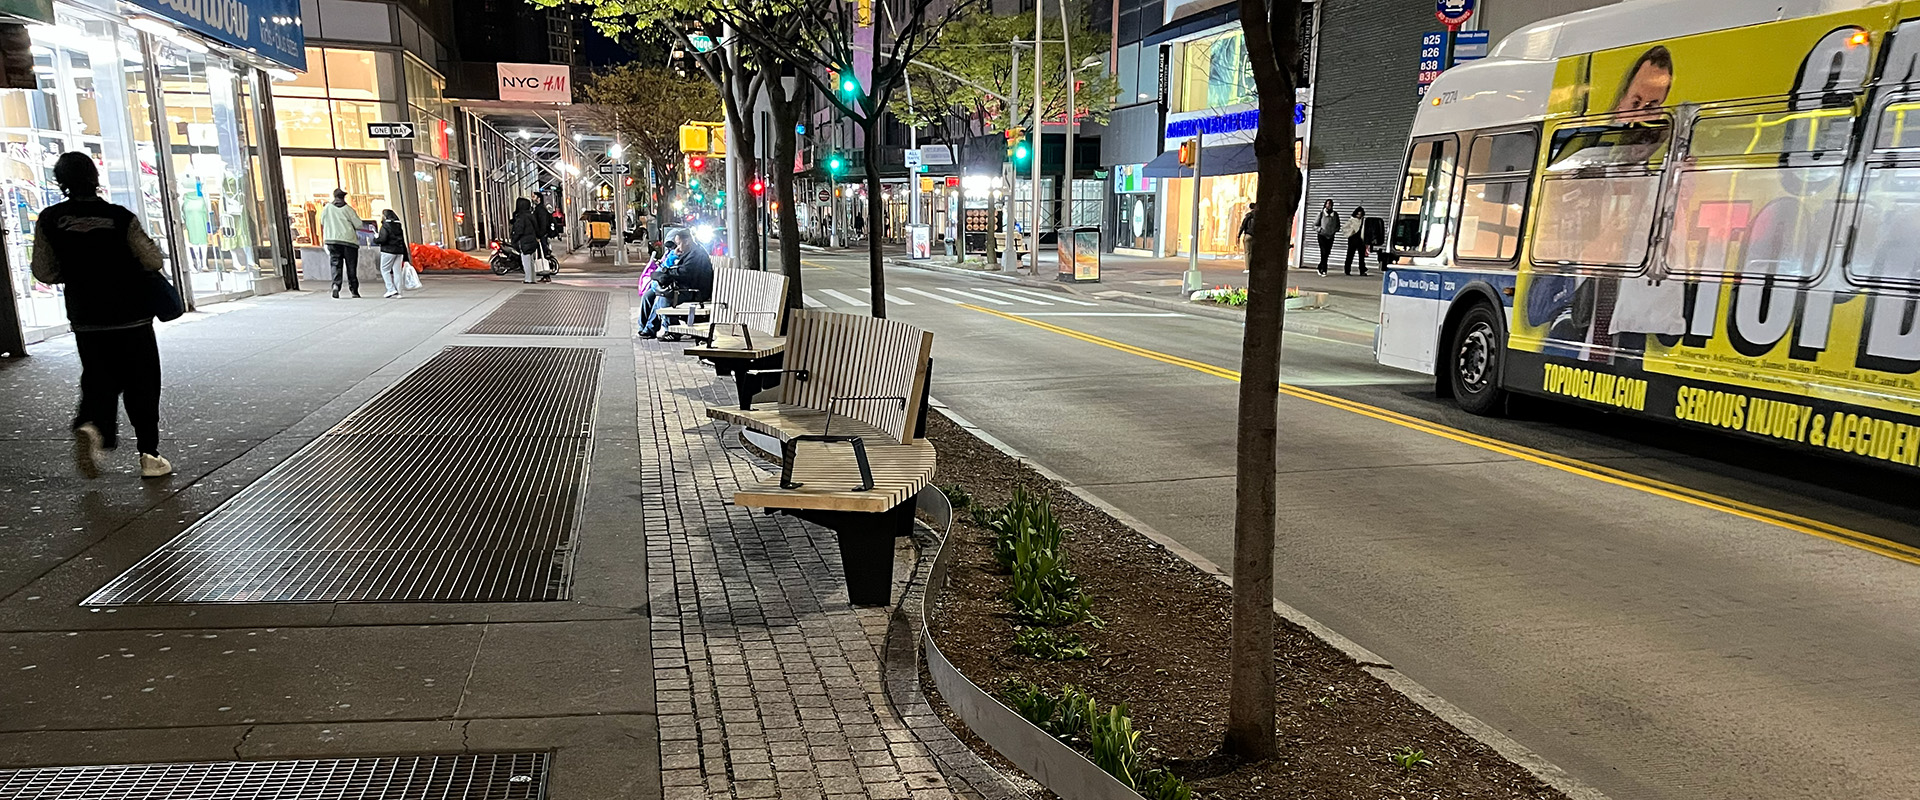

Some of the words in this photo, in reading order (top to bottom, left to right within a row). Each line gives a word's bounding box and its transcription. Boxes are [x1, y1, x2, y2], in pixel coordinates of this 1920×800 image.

[1424, 35, 1440, 45] B25
[1422, 48, 1439, 57] B26
[1421, 61, 1437, 71] B38
[1420, 72, 1437, 81] B38
[502, 76, 540, 89] NYC
[374, 127, 389, 135] ONE
[392, 127, 408, 136] WAY
[1399, 279, 1409, 288] New
[1420, 281, 1429, 291] City
[1430, 281, 1439, 290] Bus
[1543, 363, 1648, 411] TOPDOGLAW.COM
[1675, 385, 1747, 431] SERIOUS
[1746, 397, 1813, 443] INJURY
[1809, 414, 1826, 447] &
[1826, 411, 1920, 467] ACCIDEN
